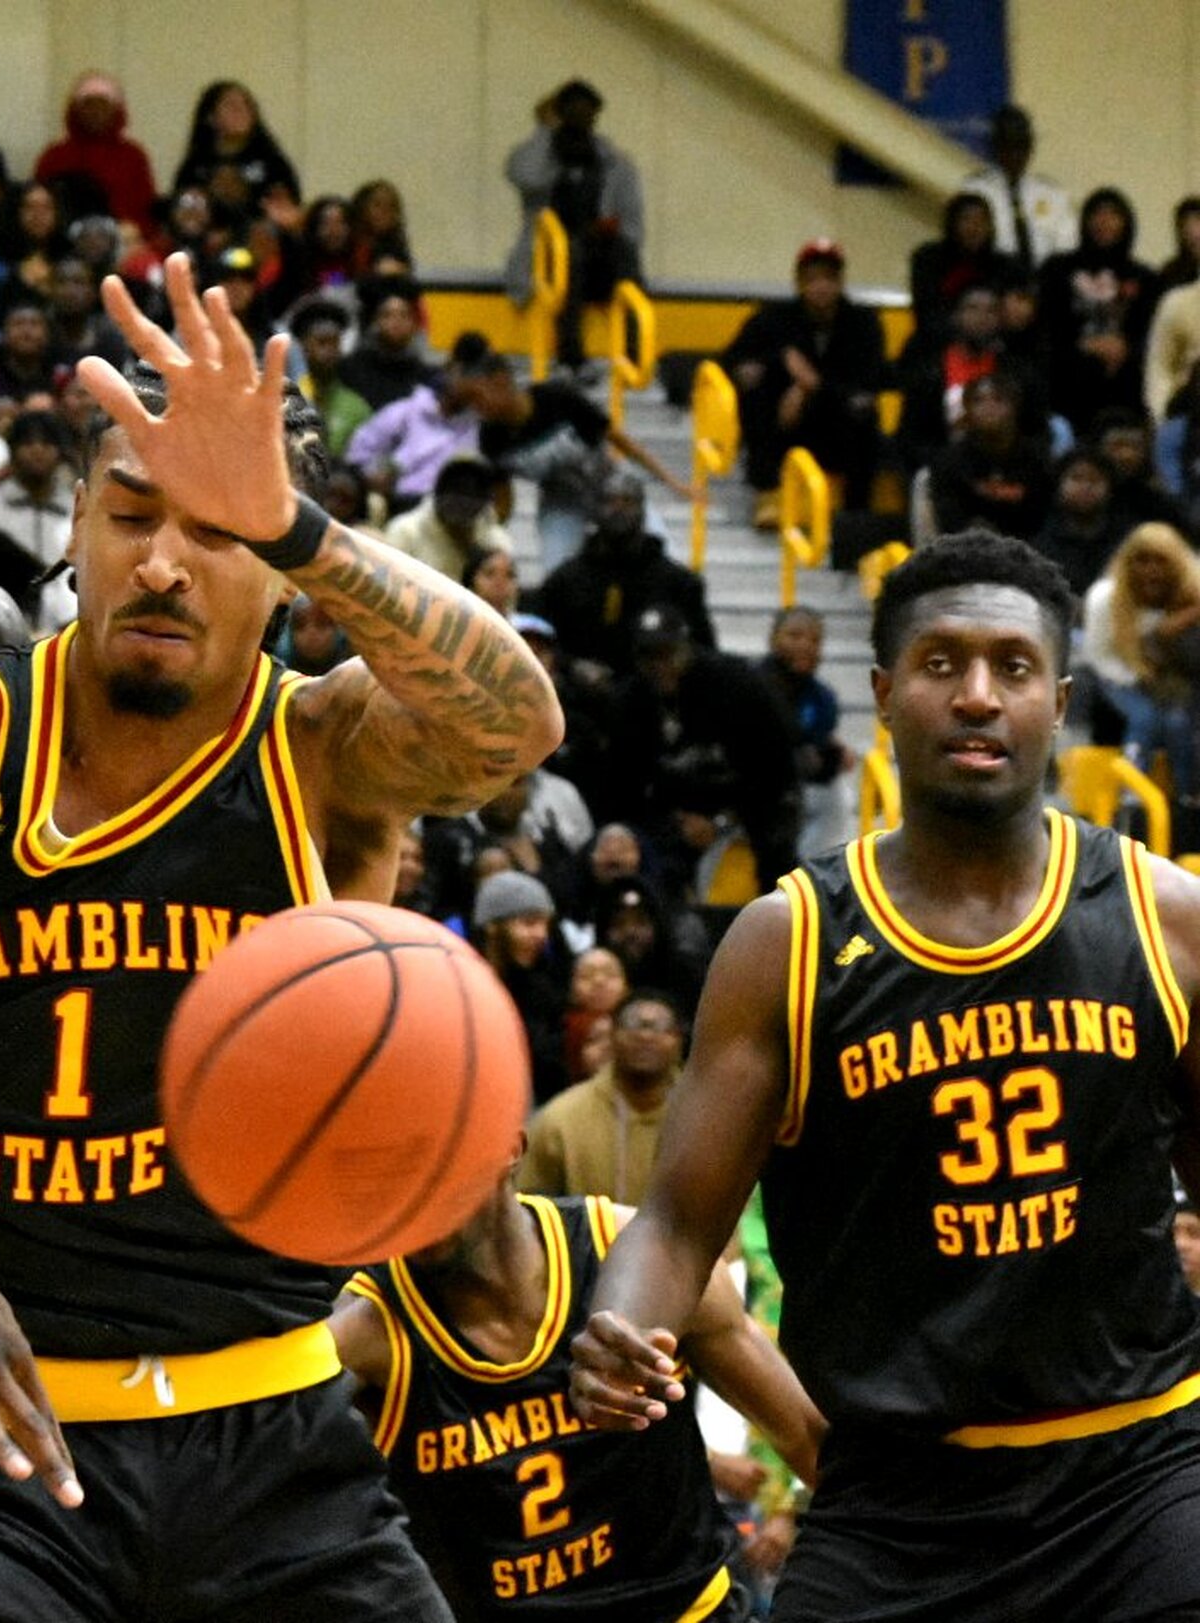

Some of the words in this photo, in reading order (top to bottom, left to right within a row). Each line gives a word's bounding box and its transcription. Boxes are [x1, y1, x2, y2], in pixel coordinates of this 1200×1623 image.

[45, 987, 93, 1119] 1
[838, 999, 1138, 1099] GRAMBLING
[930, 1065, 1067, 1186] 32
[932, 1185, 1079, 1257] STATE
[416, 1393, 597, 1475] GRAMBL
[515, 1450, 571, 1540] 2
[492, 1523, 614, 1600] STATE
